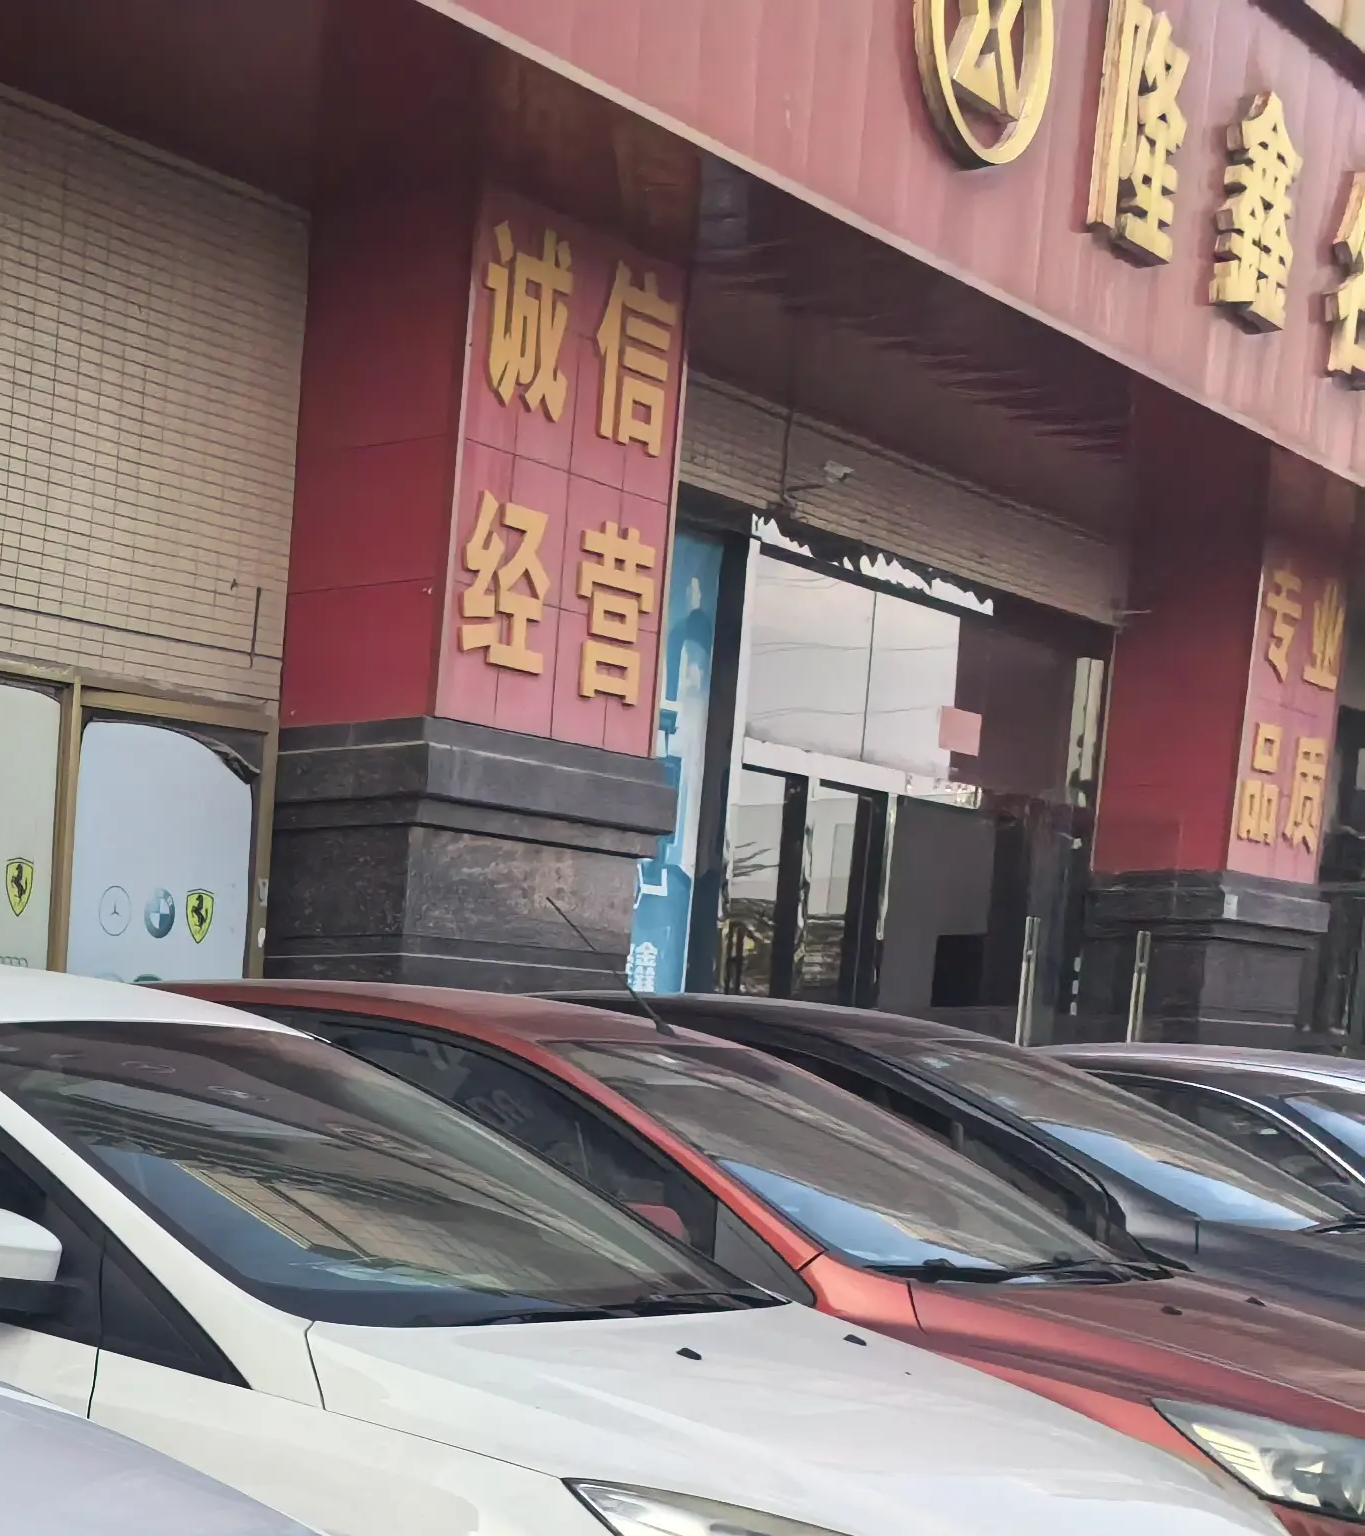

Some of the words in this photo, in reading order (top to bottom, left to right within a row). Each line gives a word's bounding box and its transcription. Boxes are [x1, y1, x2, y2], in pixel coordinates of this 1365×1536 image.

[484, 220, 676, 457] 诚信
[460, 489, 655, 705] 经营
[1263, 563, 1346, 691] 专业
[1237, 722, 1325, 854] 品质
